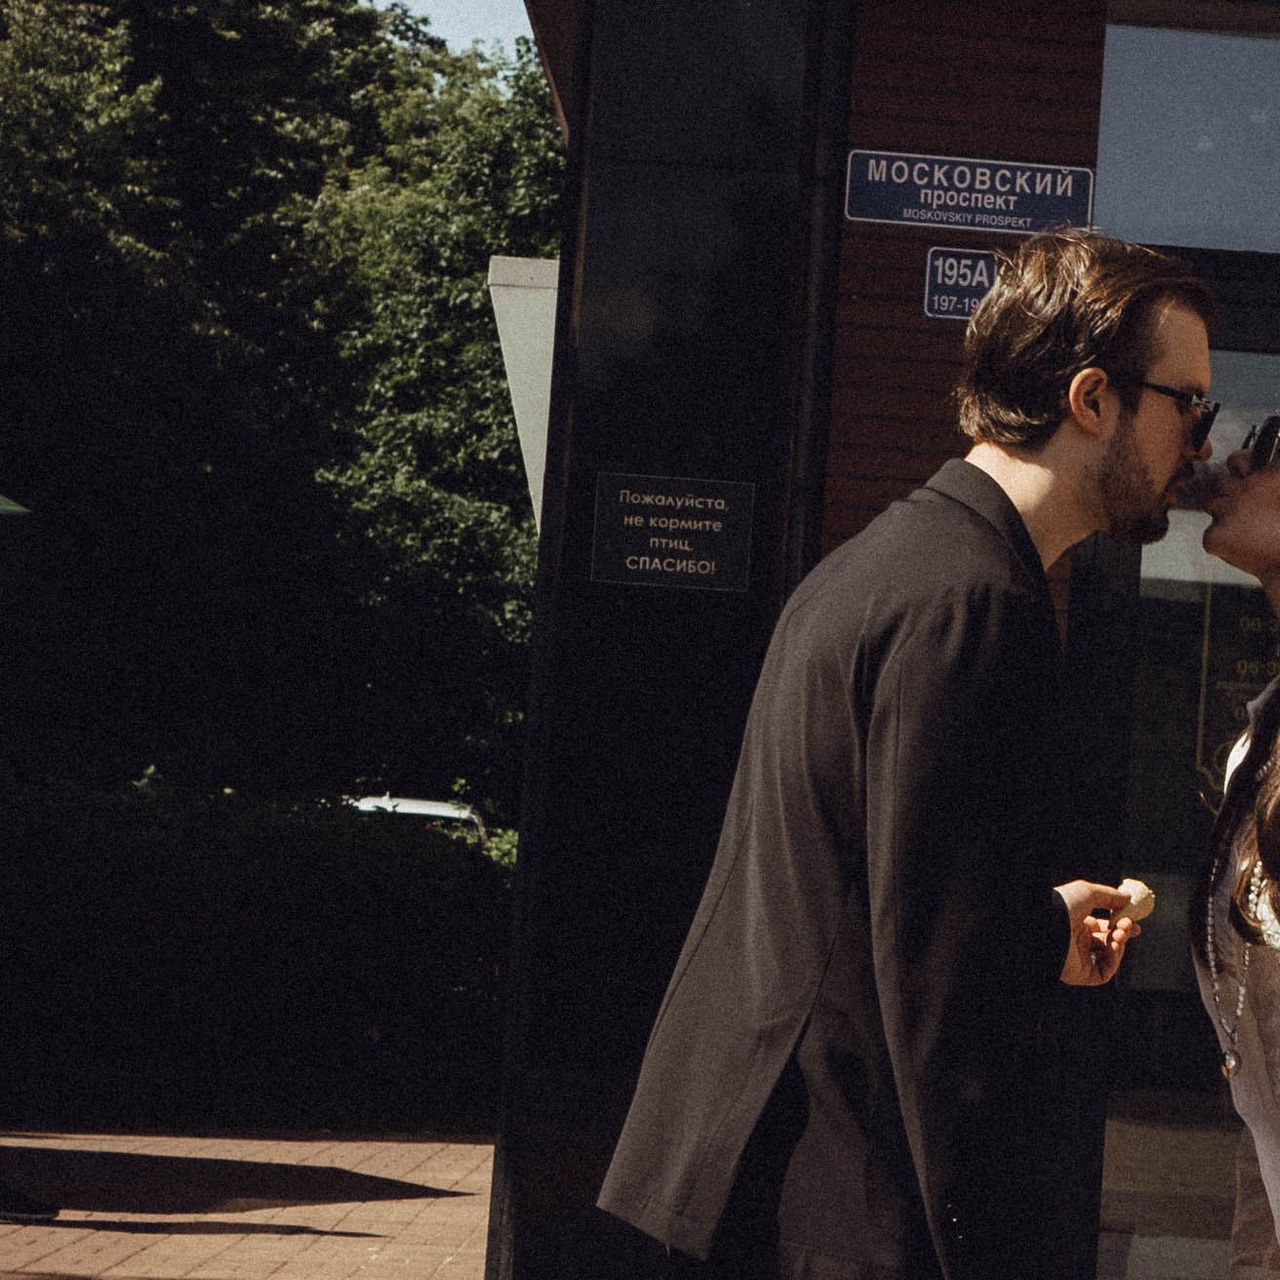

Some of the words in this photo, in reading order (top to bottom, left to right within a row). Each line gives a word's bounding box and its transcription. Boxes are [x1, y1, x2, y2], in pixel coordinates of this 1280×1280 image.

[867, 158, 1074, 197] МОСКОВСКИЙ
[919, 188, 1018, 211] проспект
[903, 208, 973, 223] MOSKOVSKIY
[975, 213, 1032, 228] PROSPEKT
[932, 295, 981, 312] 197-19
[618, 489, 730, 511] Пожалуйста,
[624, 515, 645, 528] не
[649, 517, 724, 532] кормите
[625, 555, 716, 575] СПАСИБО!
